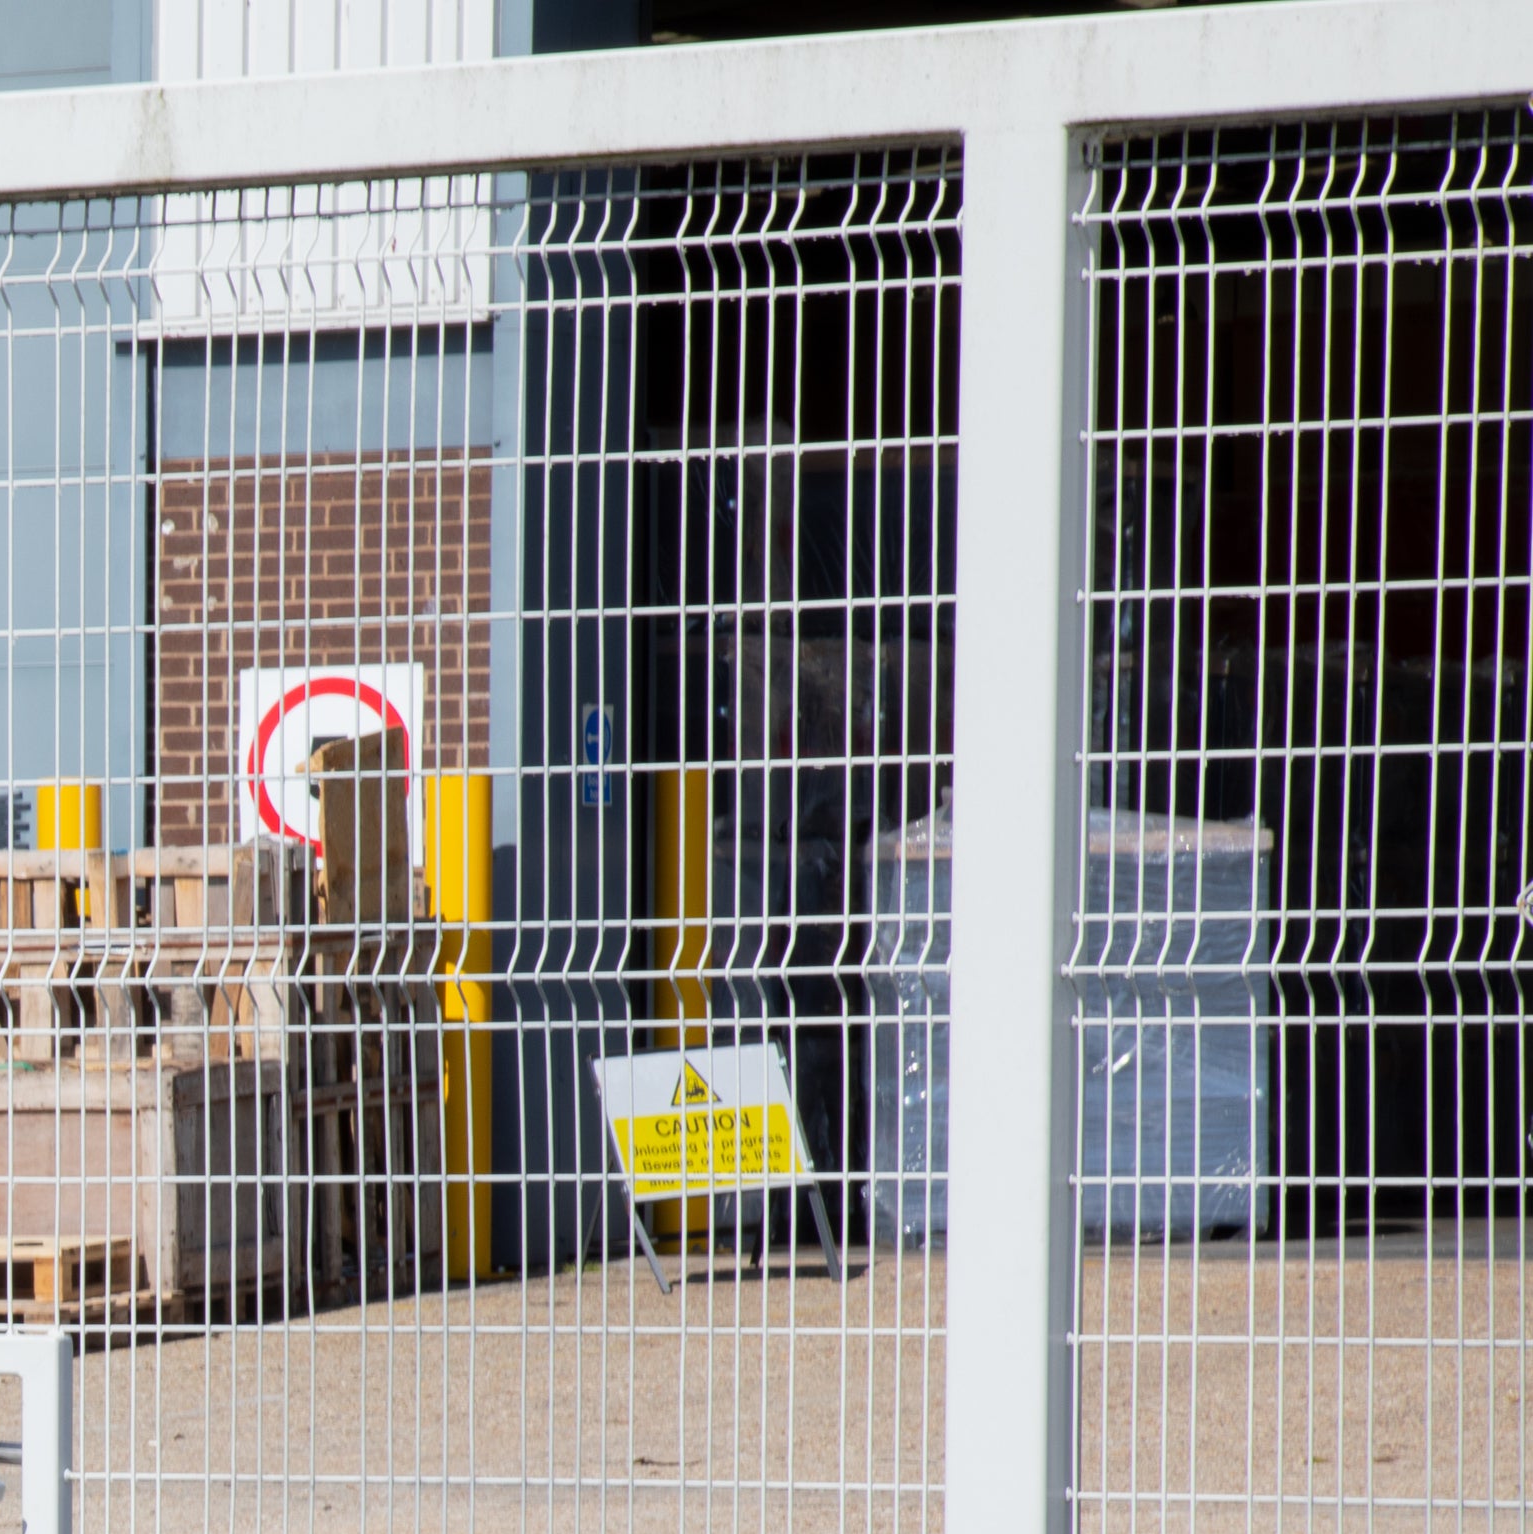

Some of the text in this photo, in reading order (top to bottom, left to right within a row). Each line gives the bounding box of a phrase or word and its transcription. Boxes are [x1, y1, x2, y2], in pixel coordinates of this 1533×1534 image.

[654, 1111, 751, 1138] CAUTION
[633, 1141, 698, 1157] nloadig
[642, 1158, 694, 1172] Bewae
[720, 1152, 748, 1164] fok
[754, 1146, 781, 1160] lits
